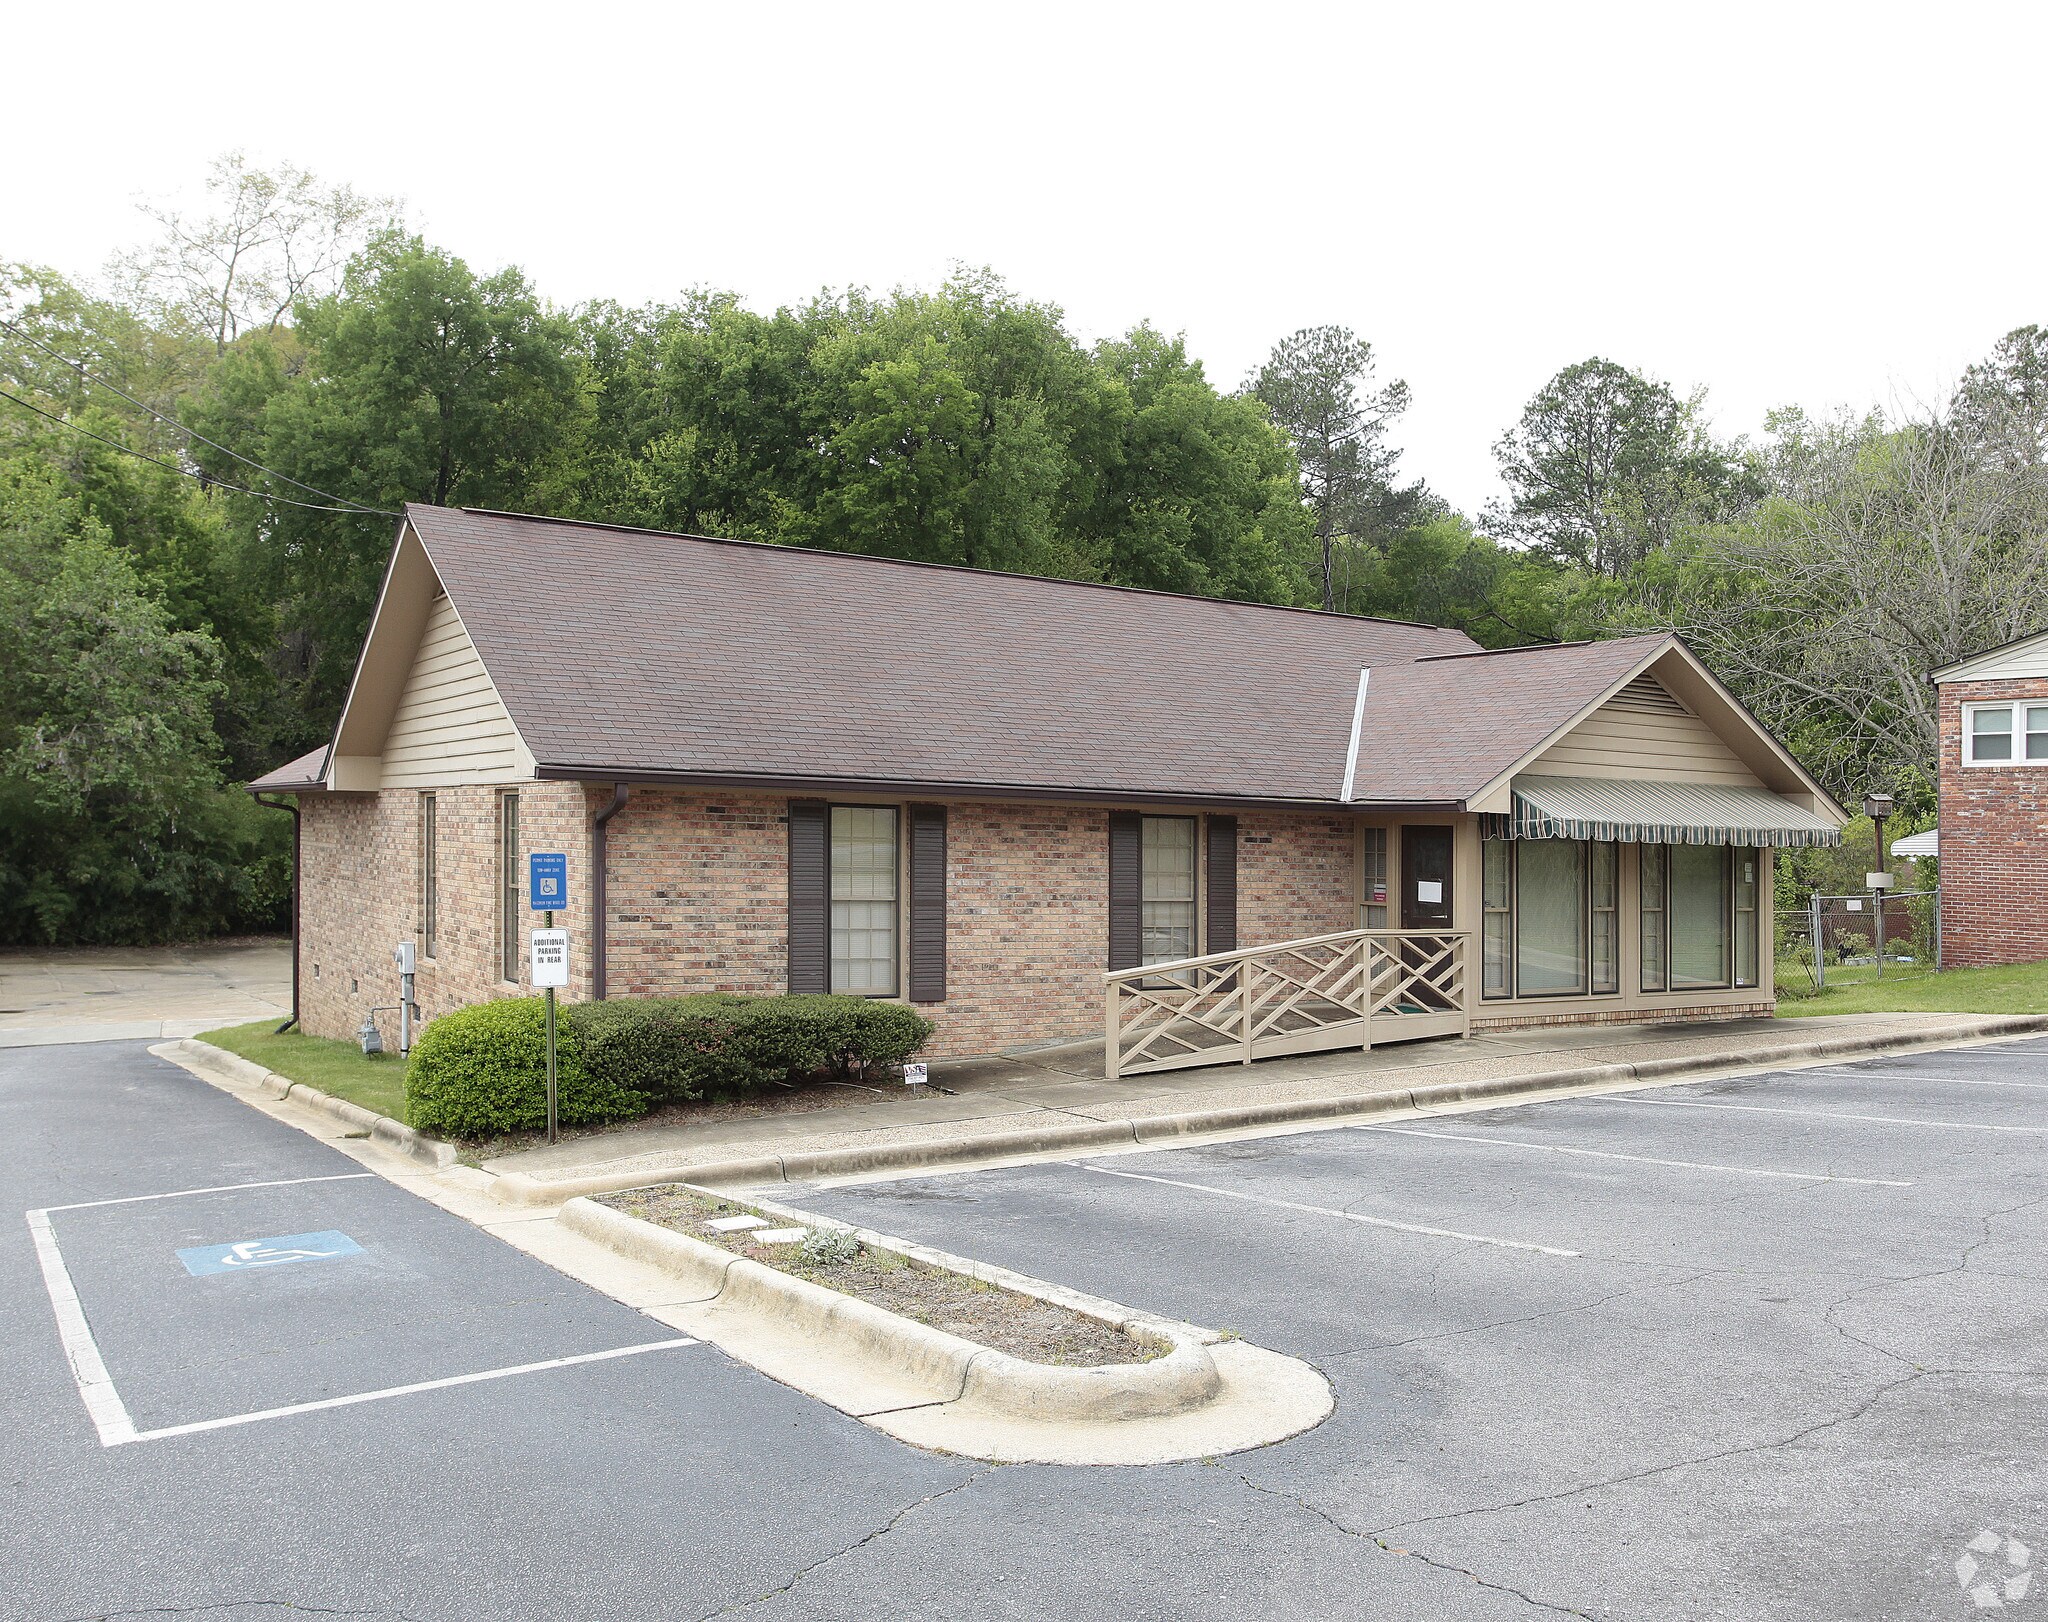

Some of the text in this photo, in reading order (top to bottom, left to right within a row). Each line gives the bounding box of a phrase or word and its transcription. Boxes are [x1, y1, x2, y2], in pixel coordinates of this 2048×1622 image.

[538, 947, 561, 955] PARKING
[538, 956, 561, 964] IN REAR
